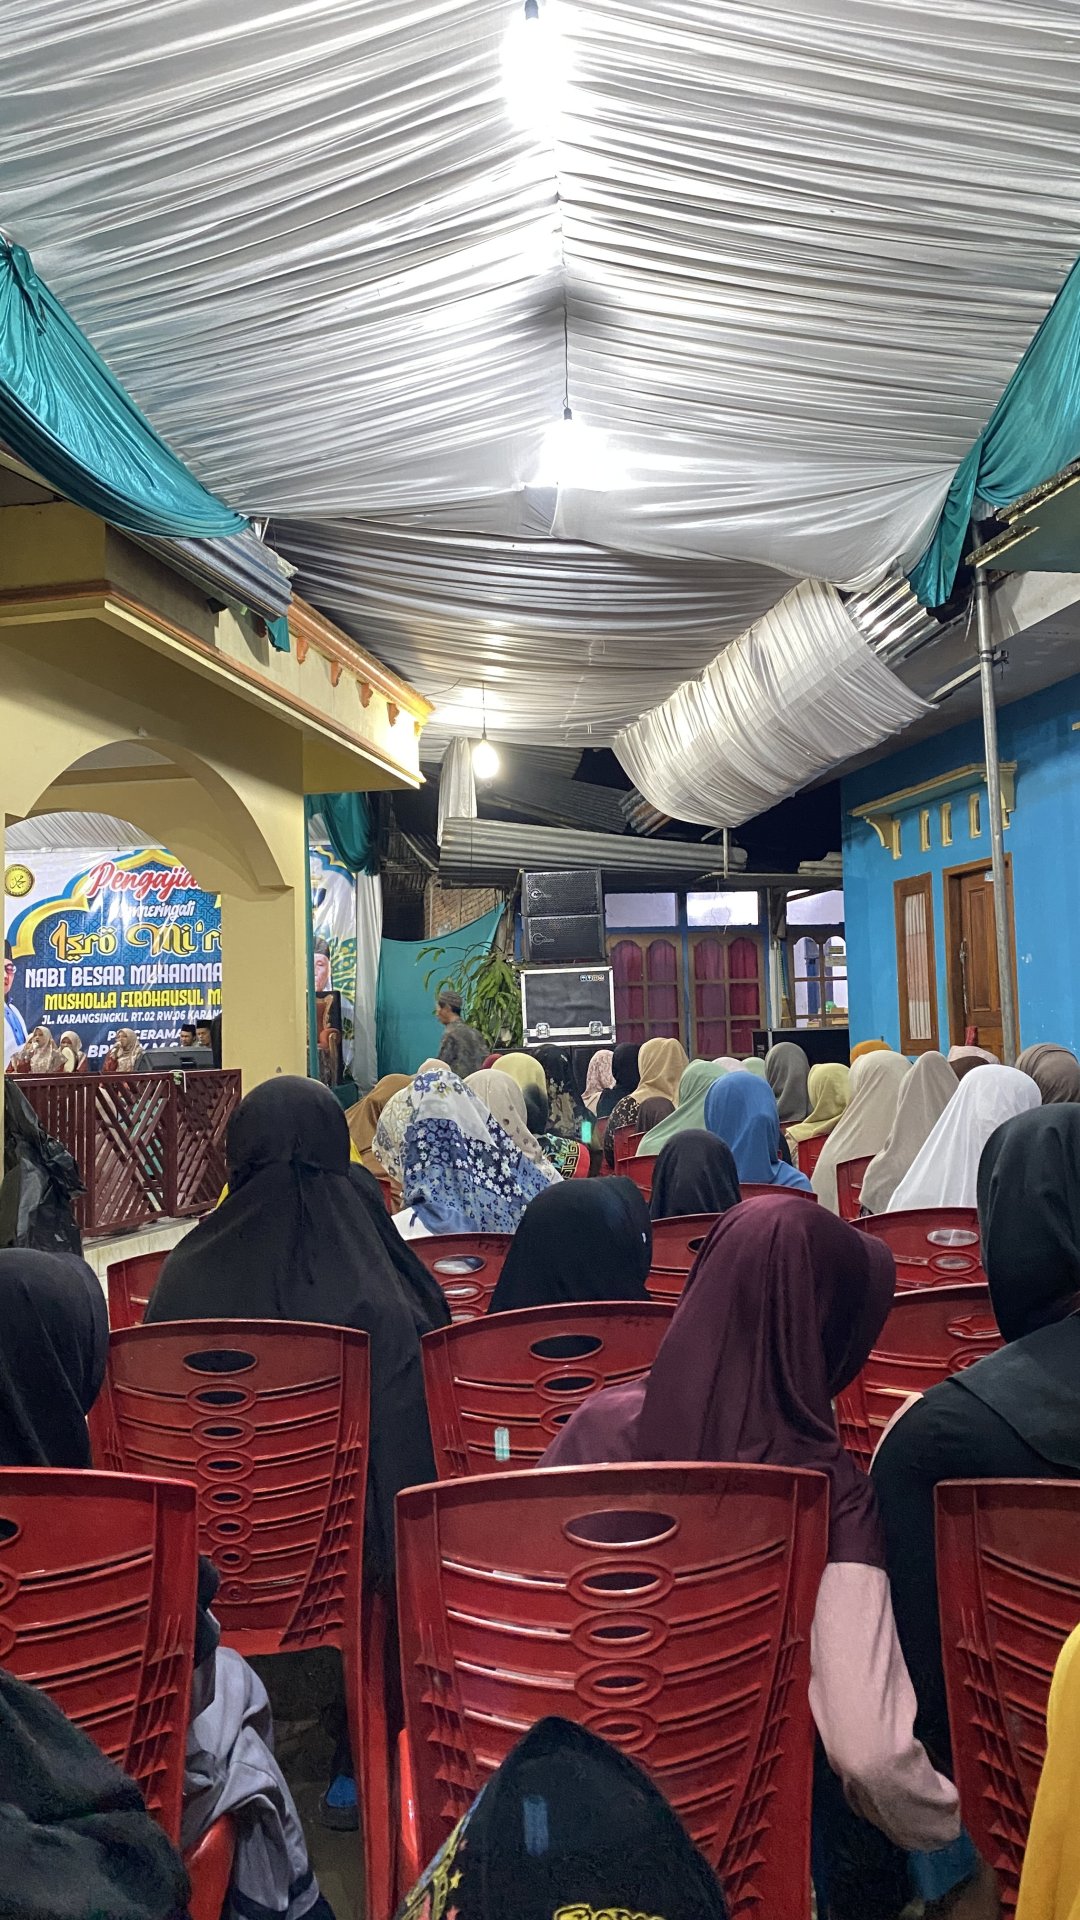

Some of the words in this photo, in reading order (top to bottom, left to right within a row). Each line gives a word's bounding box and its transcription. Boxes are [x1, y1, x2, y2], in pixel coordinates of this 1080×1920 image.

[86, 862, 199, 899] Pengajia
[126, 921, 222, 956] Mi'r
[25, 967, 66, 988] NABI
[72, 965, 124, 987] BESAR
[130, 962, 222, 985] MUHAMMA
[44, 992, 116, 1011] MUSHOLLA
[120, 989, 203, 1008] FIRDHAUSUL
[207, 989, 222, 1006] M
[41, 1014, 54, 1024] JL.
[56, 1011, 128, 1024] KARANGSINGKIL
[131, 1010, 155, 1022] RT.02
[156, 1009, 185, 1021] RW.06
[187, 1009, 222, 1021] KARAN
